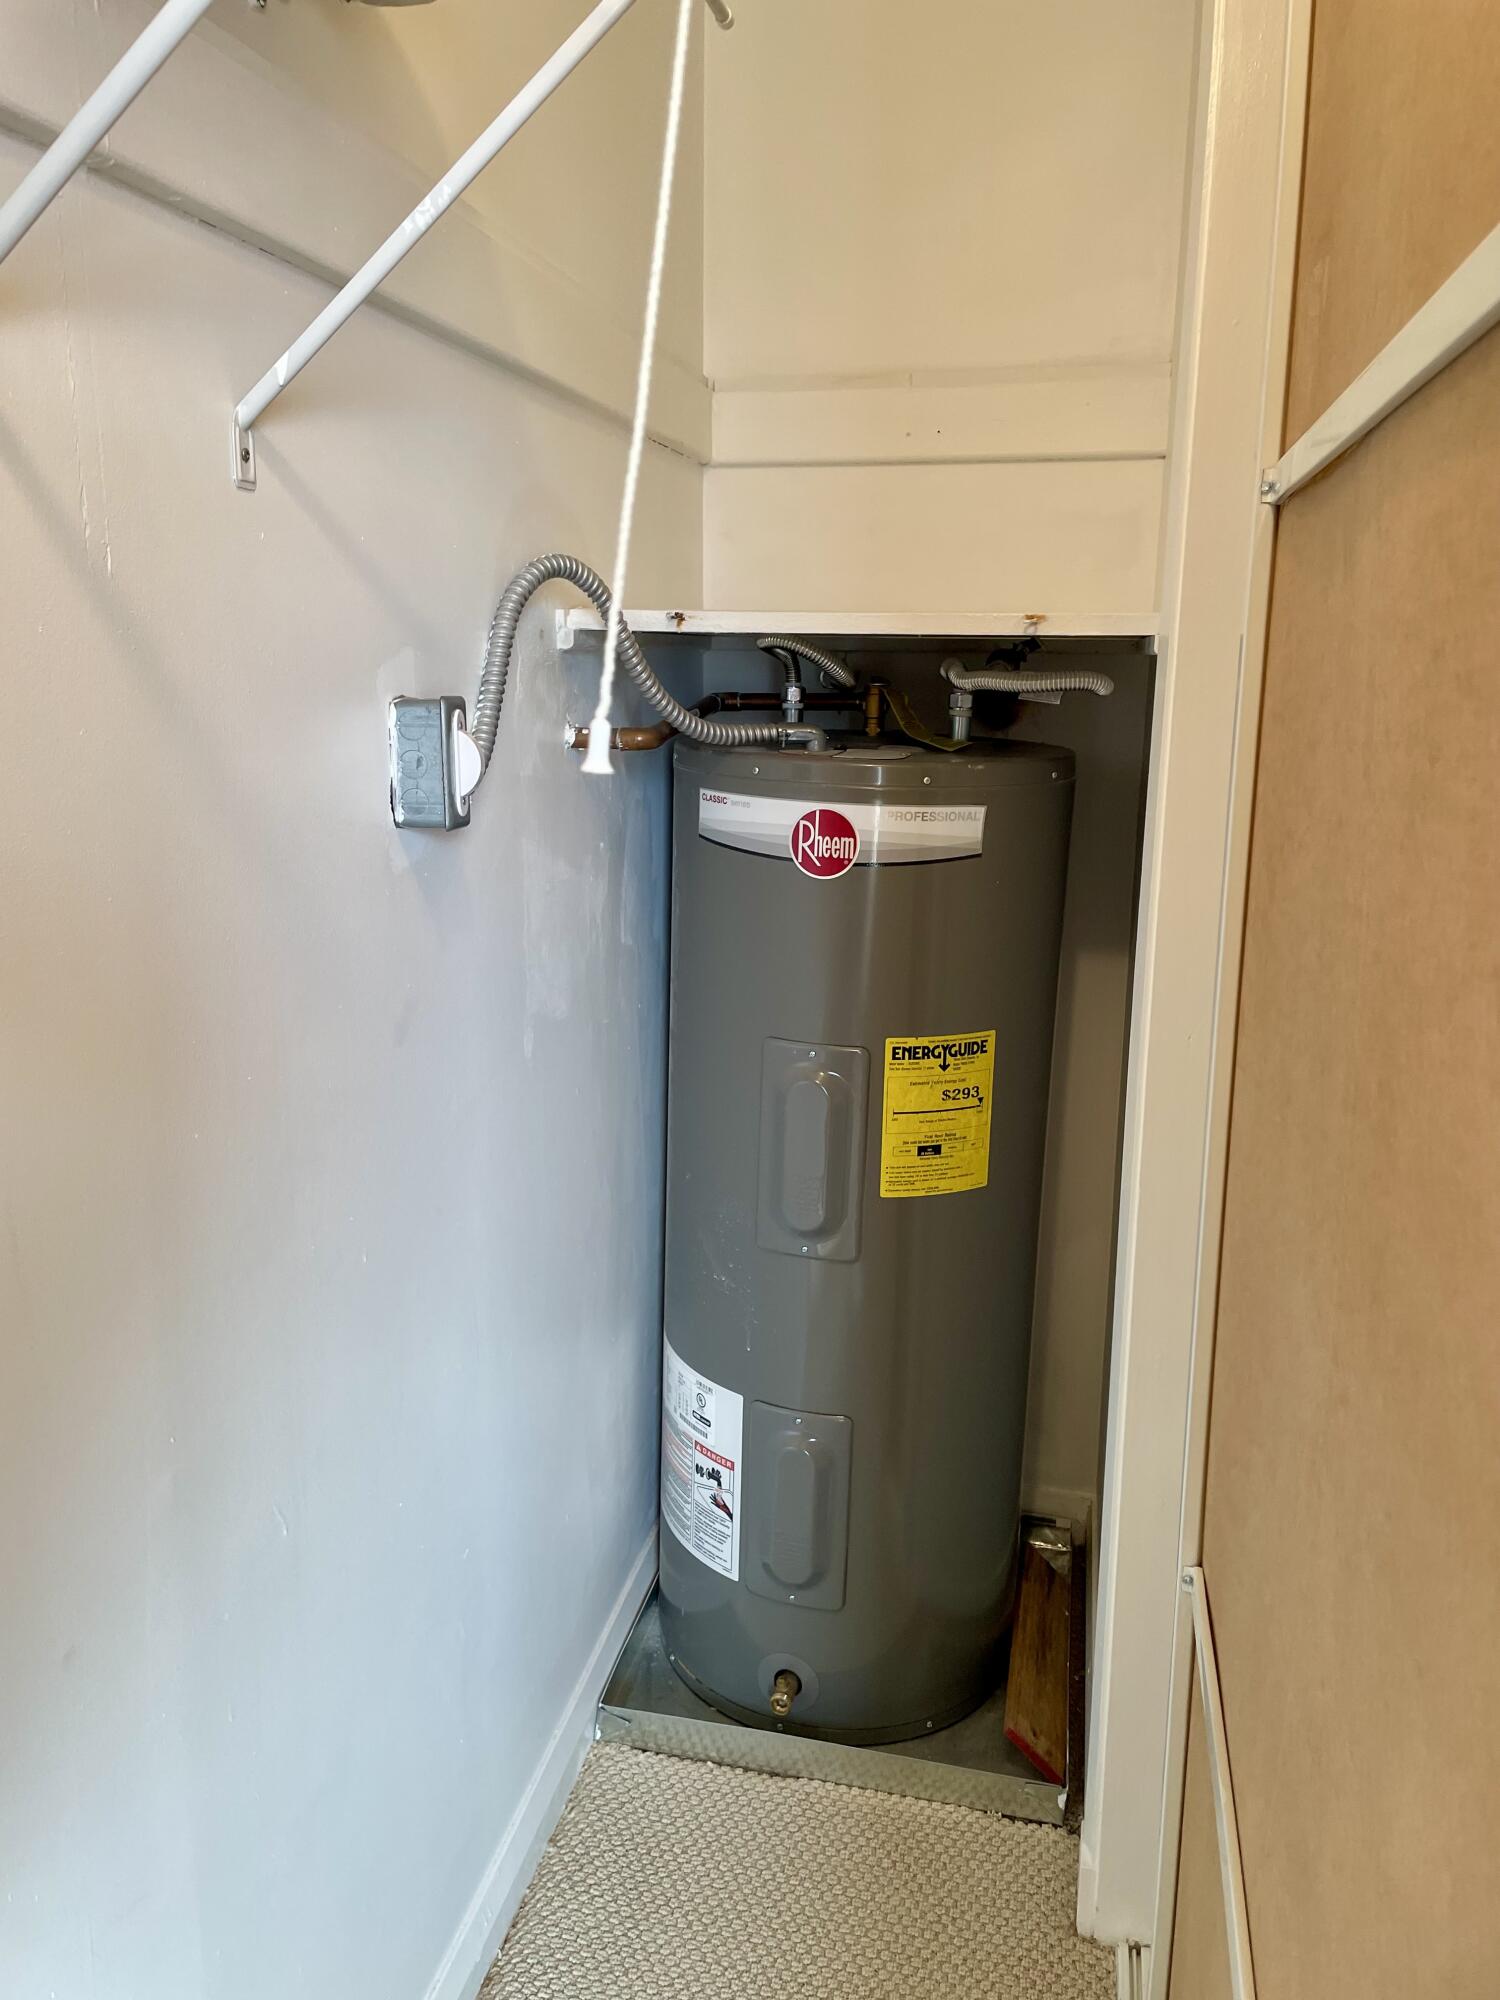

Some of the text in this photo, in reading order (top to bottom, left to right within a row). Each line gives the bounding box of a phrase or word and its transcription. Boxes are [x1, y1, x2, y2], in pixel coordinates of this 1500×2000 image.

[701, 792, 728, 805] CLASSIC
[888, 809, 981, 822] PROFESSIONAL
[798, 809, 854, 867] Rheem
[891, 1039, 988, 1061] ENERGYGUIDE
[941, 1085, 980, 1102] $293
[702, 1446, 732, 1470] DANGER
